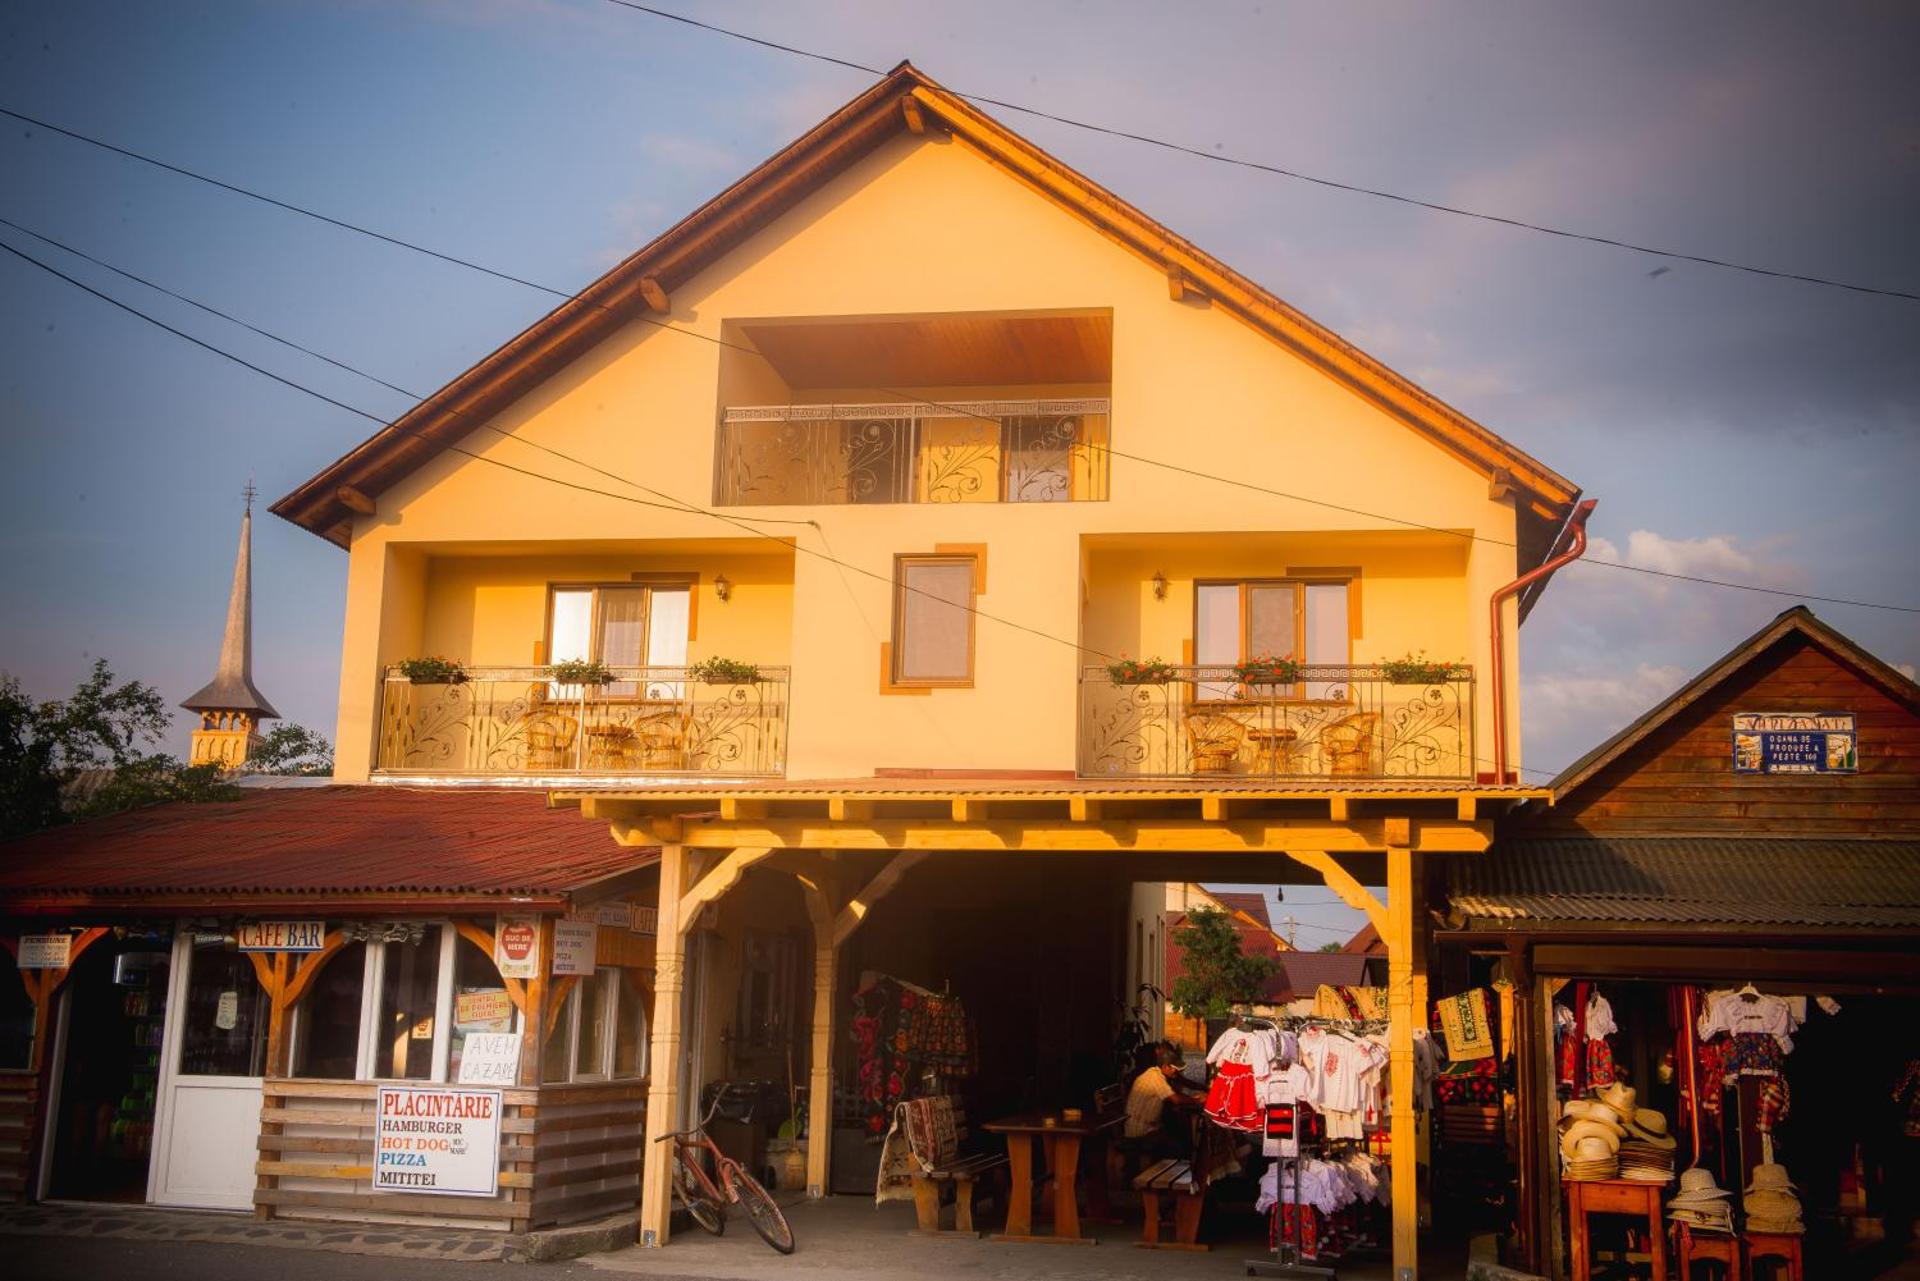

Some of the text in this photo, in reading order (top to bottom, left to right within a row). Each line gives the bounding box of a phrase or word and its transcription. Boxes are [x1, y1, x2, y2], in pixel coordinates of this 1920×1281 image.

[1769, 744, 1810, 752] PRODUSE
[1773, 753, 1800, 761] PESTE
[242, 922, 321, 947] CAFE BAR
[462, 1062, 515, 1081] CAZARE
[382, 1120, 462, 1134] HAMBURGER
[381, 1136, 449, 1151] HOT DOG
[380, 1153, 426, 1166] PIZZA
[380, 1172, 436, 1186] MITITEI
